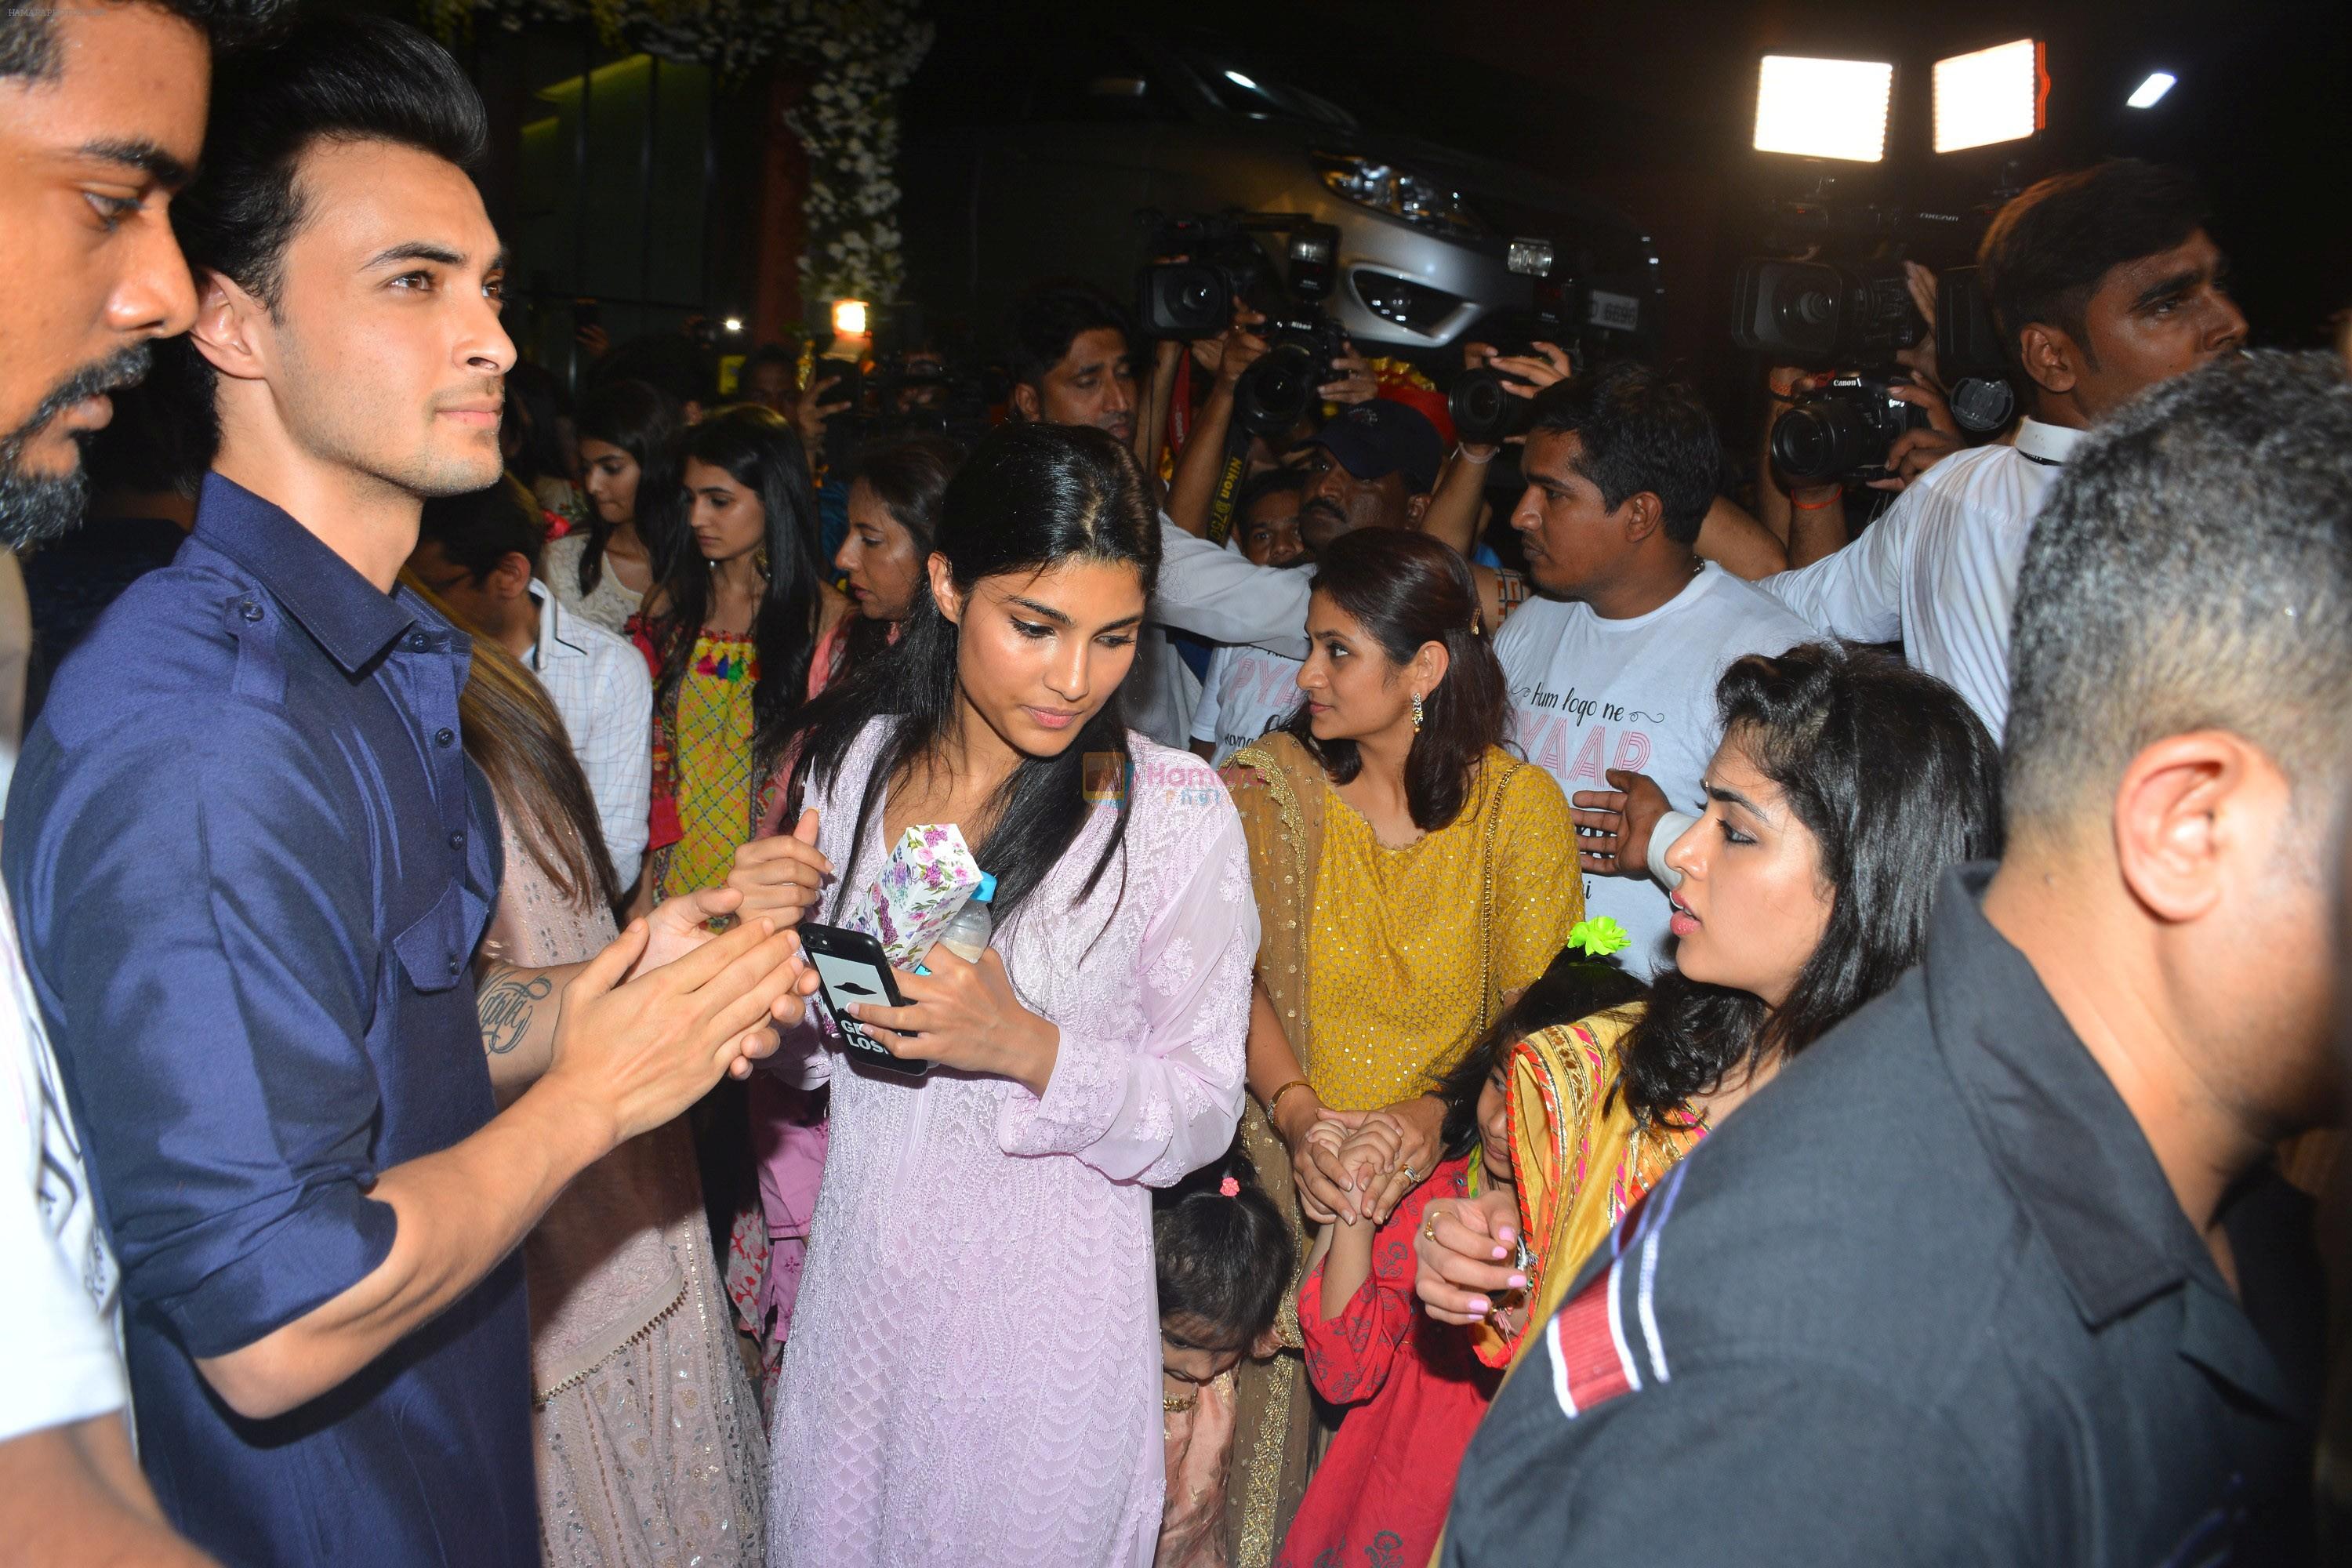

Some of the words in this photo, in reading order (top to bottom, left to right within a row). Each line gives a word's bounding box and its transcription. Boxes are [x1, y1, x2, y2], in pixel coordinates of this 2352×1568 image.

[1229, 658, 1303, 707] PYA
[1562, 687, 1597, 727] logo
[1602, 702, 1624, 722] ne
[846, 1033, 889, 1054] LOS
